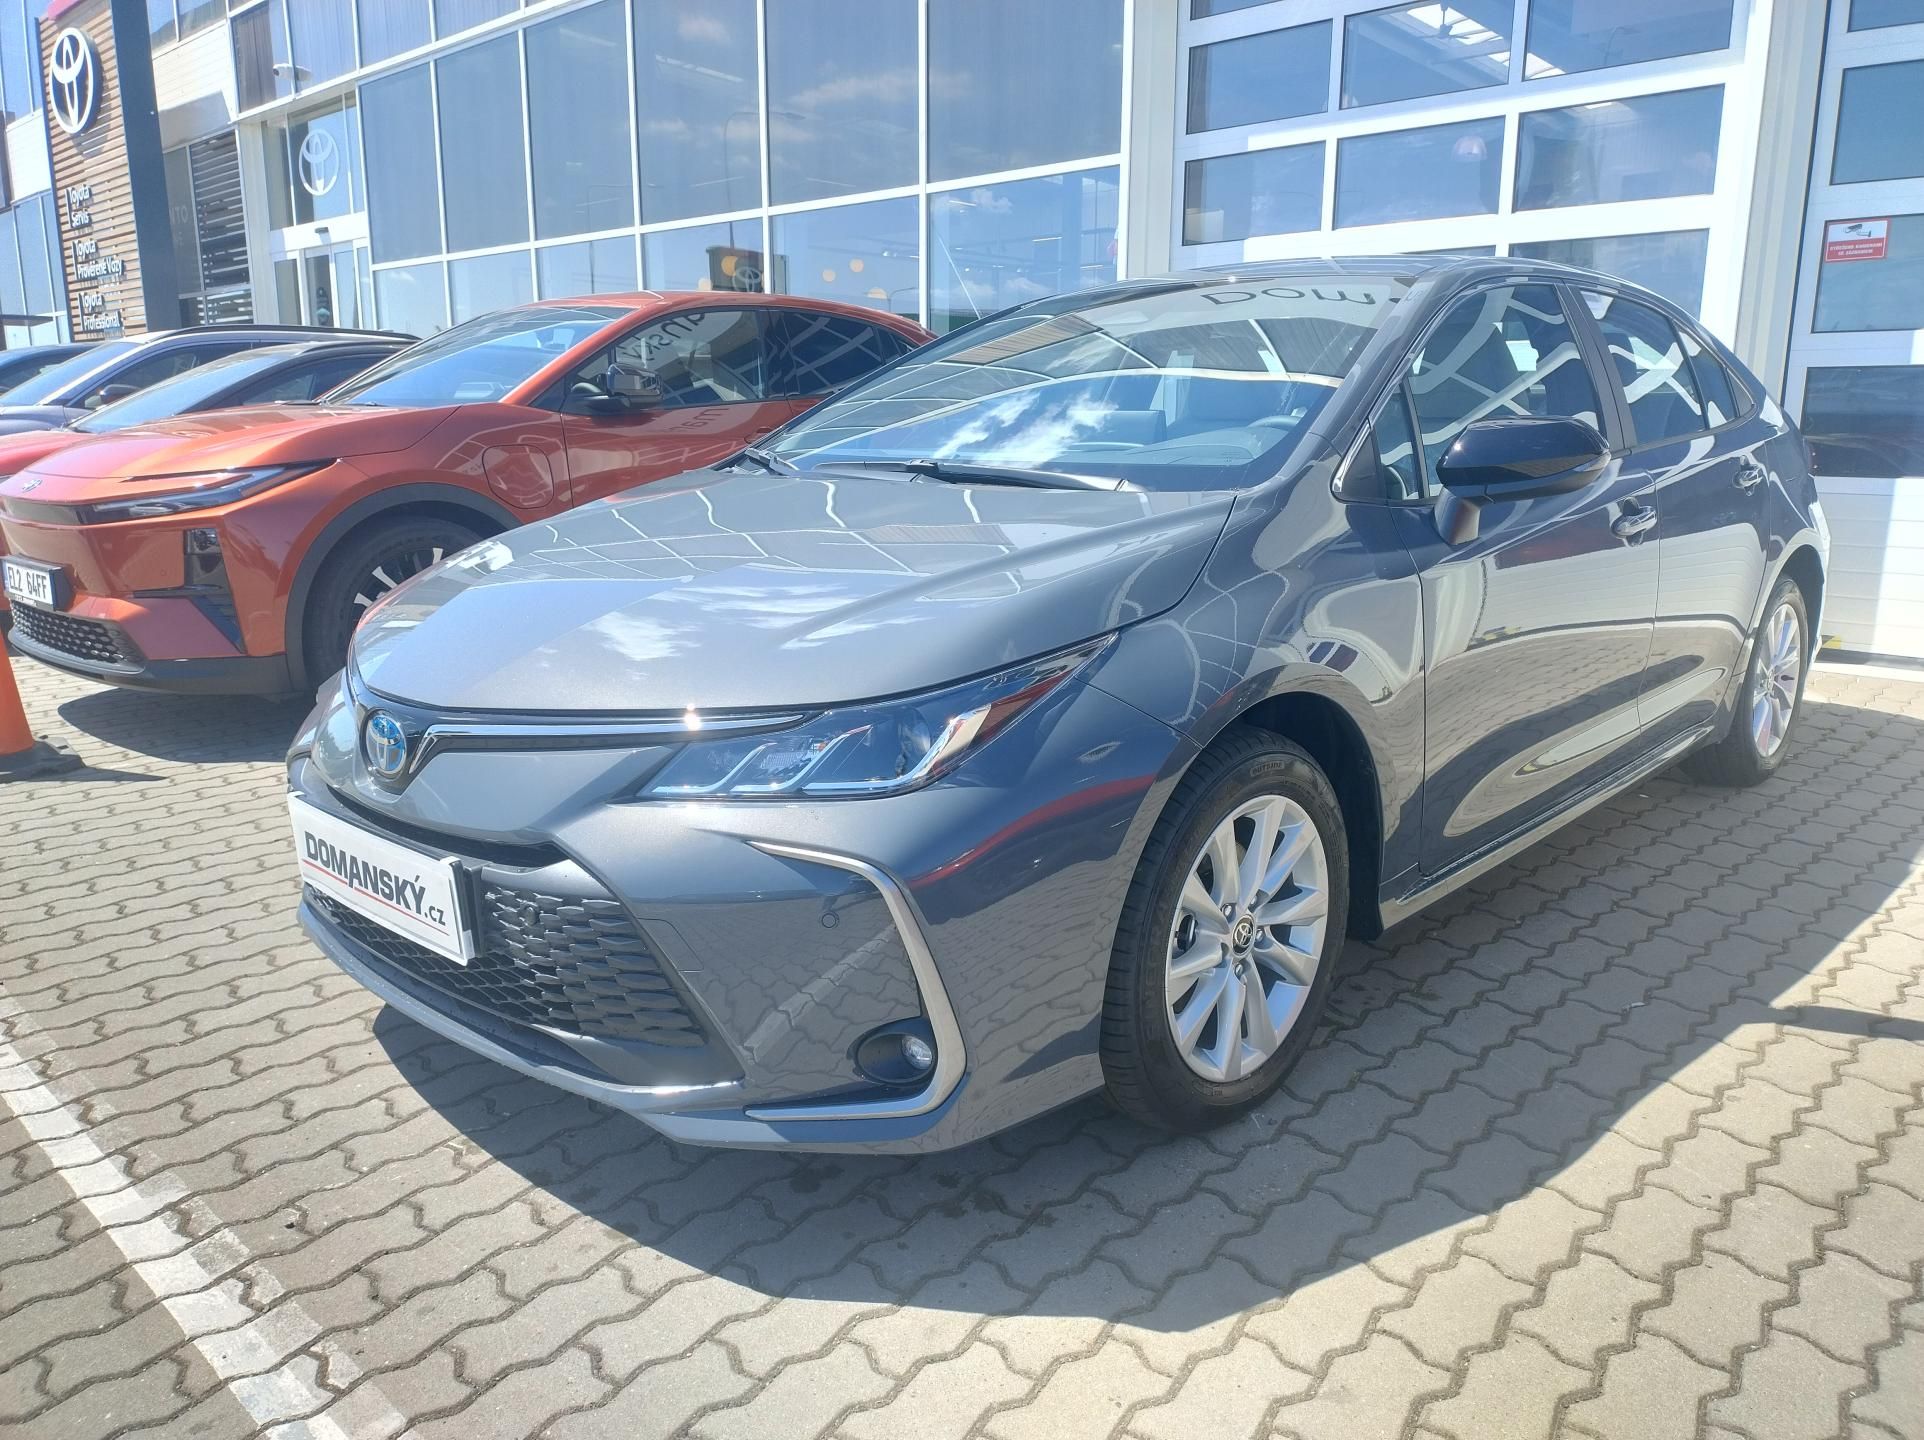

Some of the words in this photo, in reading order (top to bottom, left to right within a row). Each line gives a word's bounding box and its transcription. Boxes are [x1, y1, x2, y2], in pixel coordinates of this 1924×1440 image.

[69, 185, 90, 206] Toyota
[71, 211, 90, 227] Servis
[74, 240, 97, 258] Toyota
[106, 258, 123, 276] Vozy
[80, 292, 103, 311] Toyota
[83, 312, 121, 330] Professional
[8, 566, 23, 592] EL2
[26, 571, 47, 599] 64FF
[305, 830, 426, 915] DOMANSKÝ
